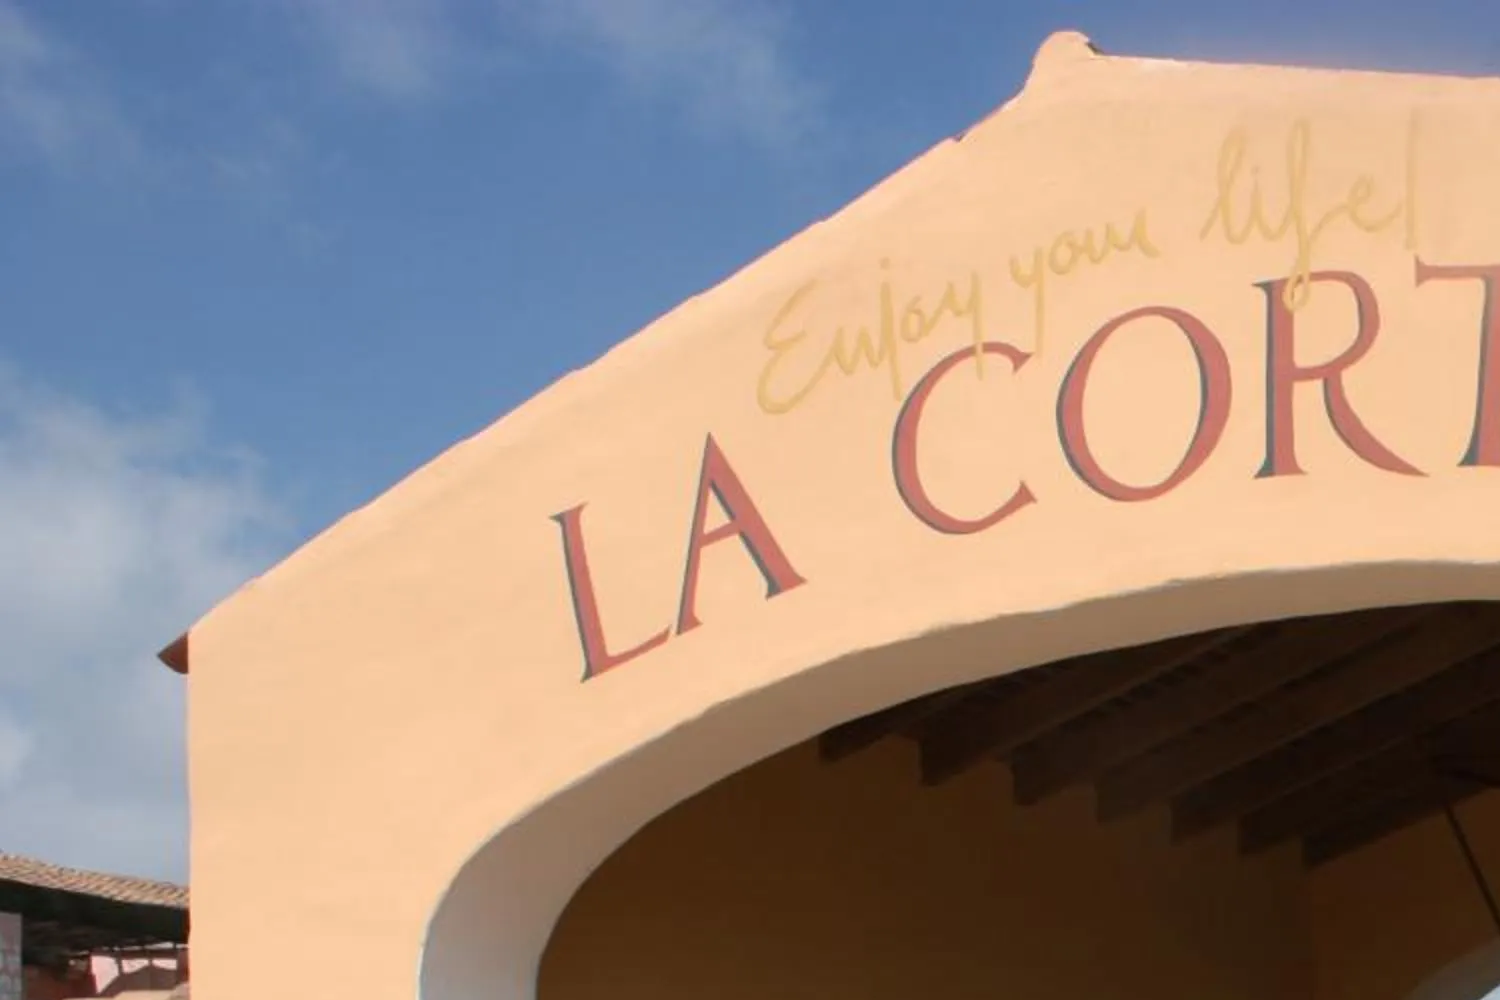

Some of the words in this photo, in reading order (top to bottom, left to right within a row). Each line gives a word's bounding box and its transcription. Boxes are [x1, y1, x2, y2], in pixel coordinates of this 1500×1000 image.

[757, 256, 986, 415] Enjoy
[1009, 206, 1161, 358] your
[548, 431, 808, 683] LA
